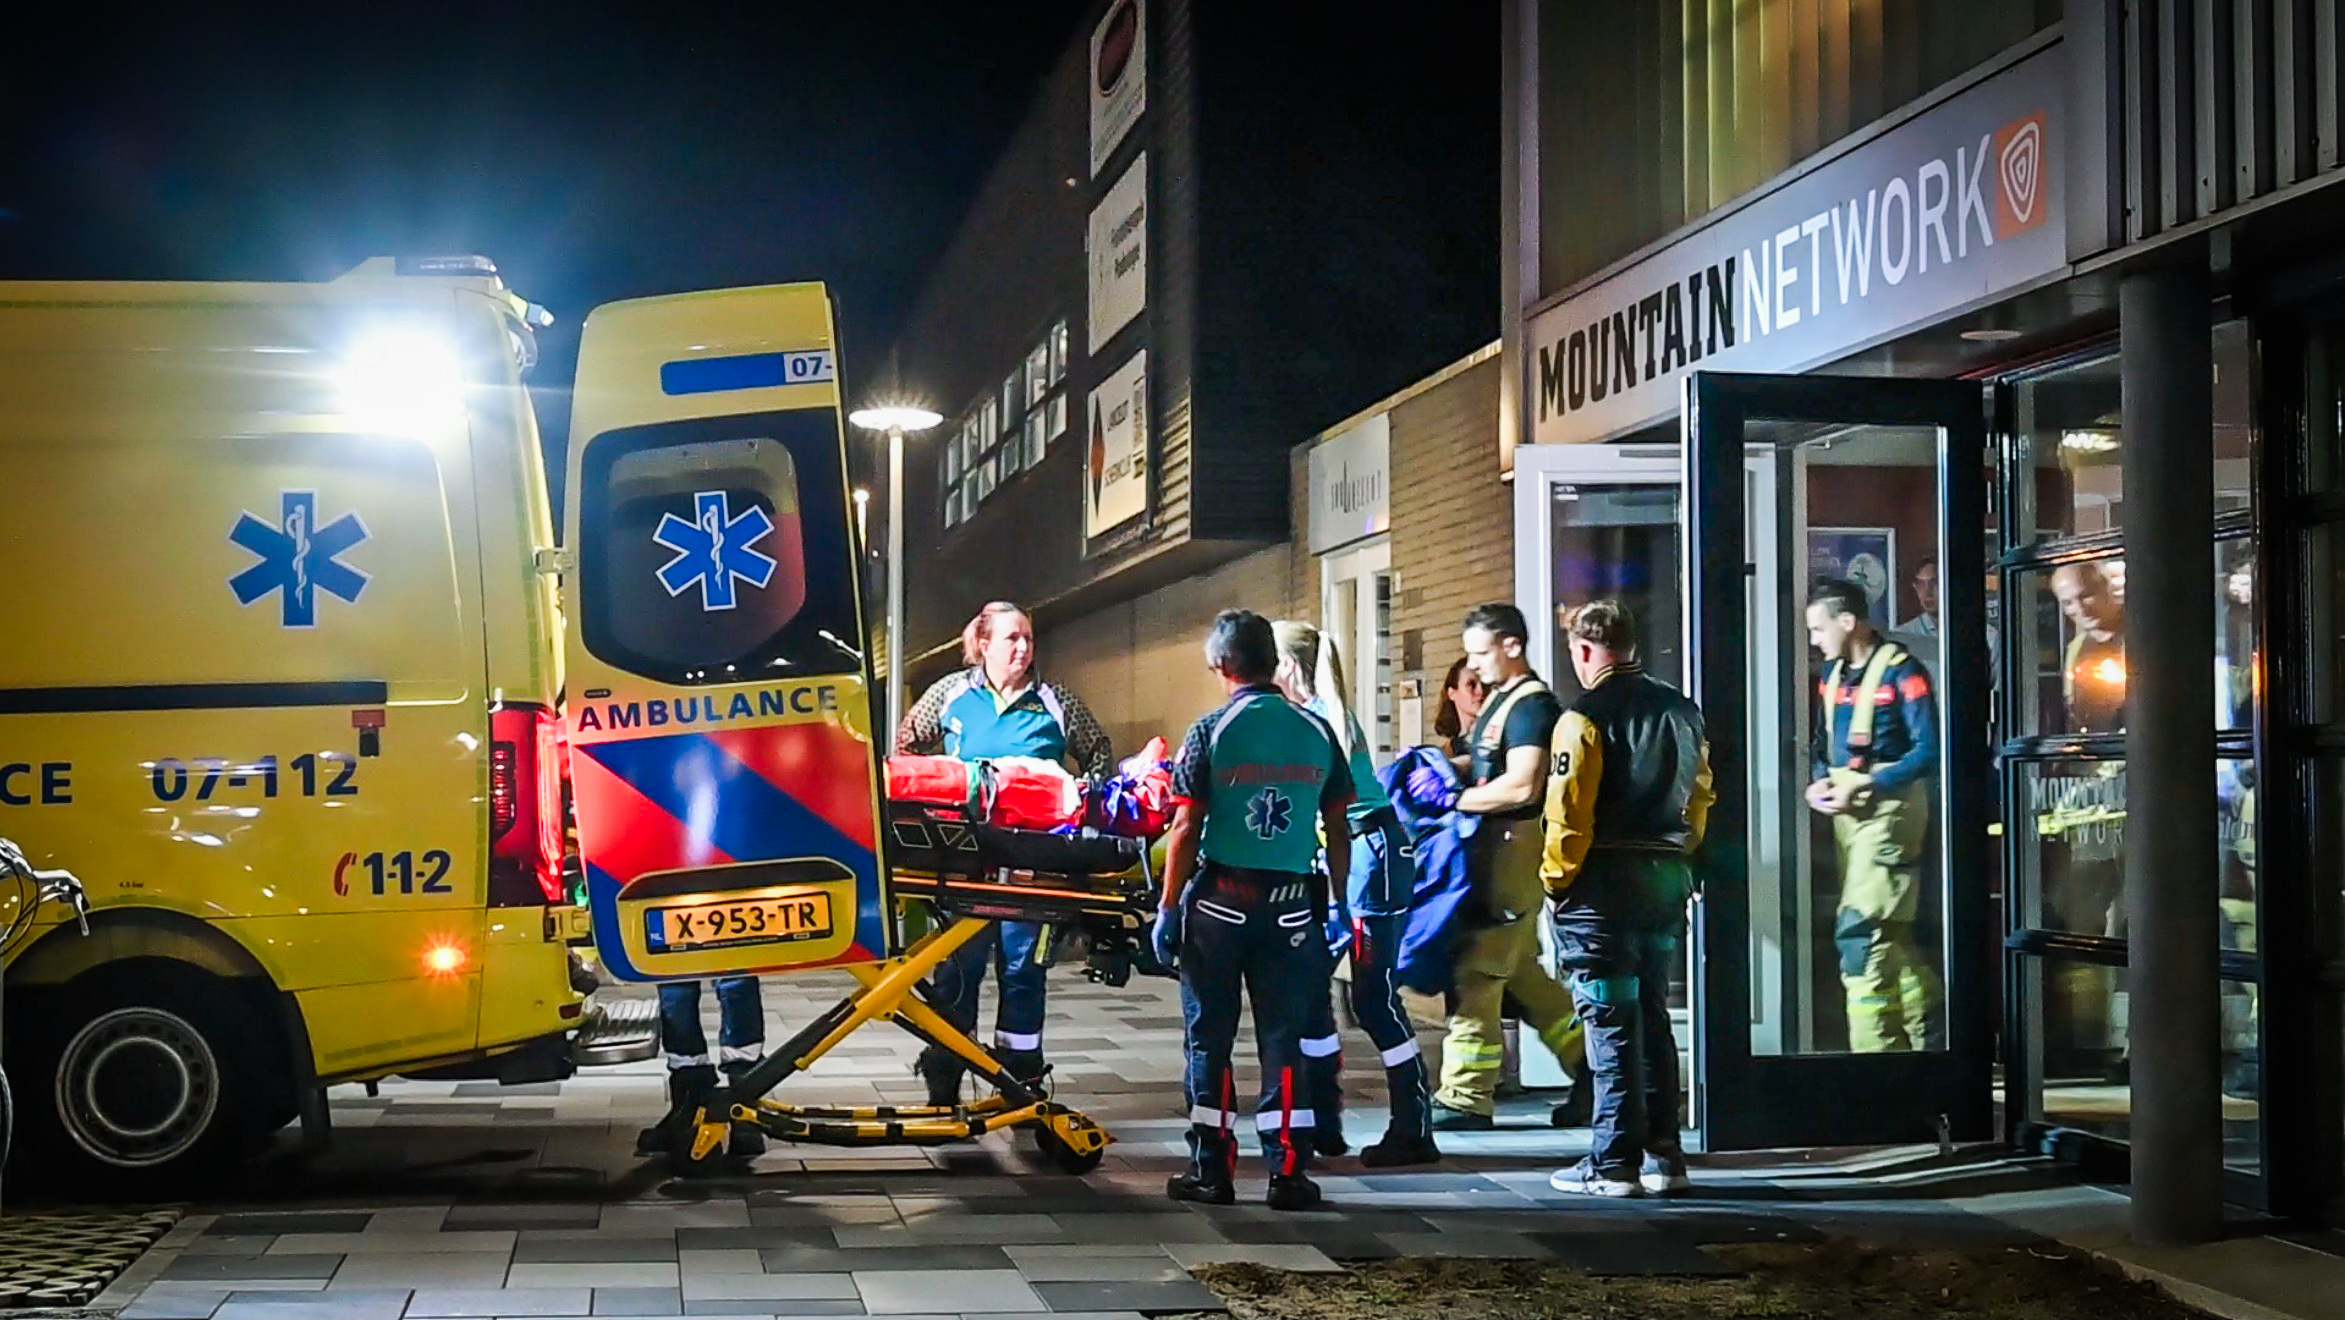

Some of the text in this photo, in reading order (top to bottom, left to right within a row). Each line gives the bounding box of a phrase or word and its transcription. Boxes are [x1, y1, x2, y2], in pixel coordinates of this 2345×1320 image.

[791, 356, 832, 377] 07-
[578, 685, 838, 732] AMBULANCE
[0, 762, 73, 805] CE
[363, 850, 453, 895] 1-1-2
[676, 902, 817, 939] X-953-TR
